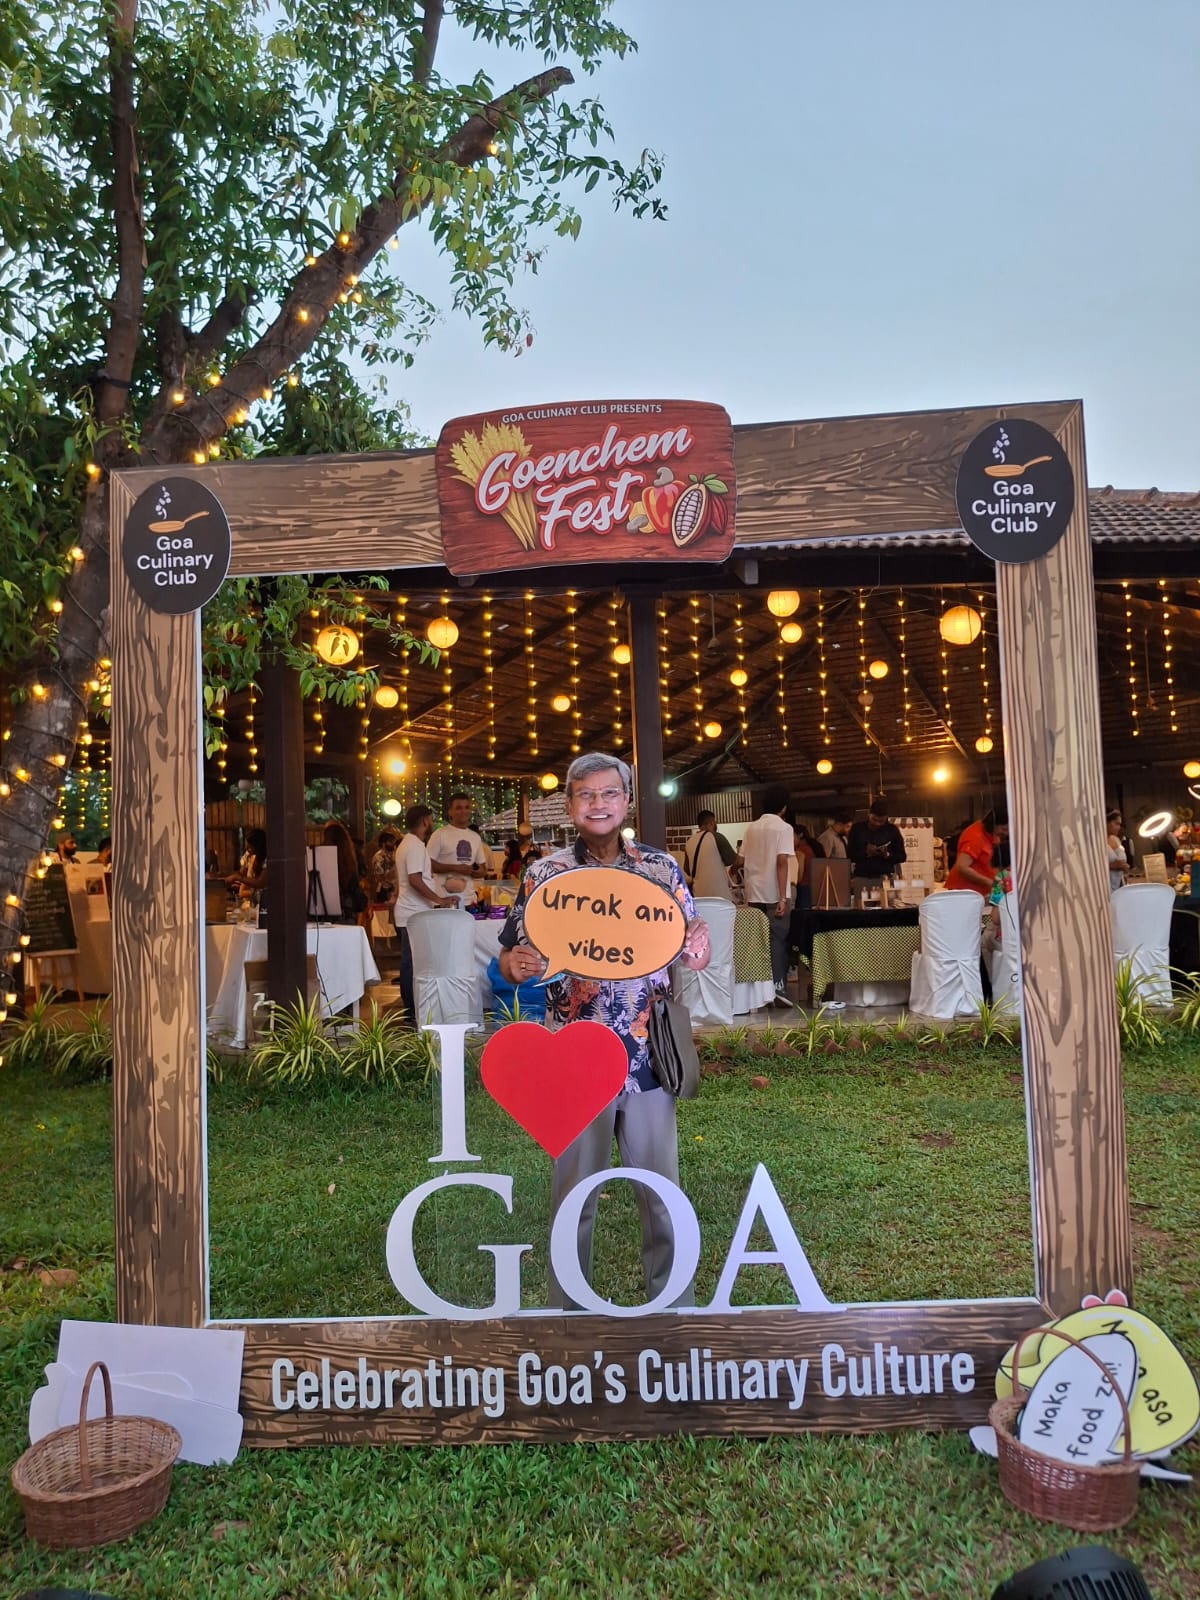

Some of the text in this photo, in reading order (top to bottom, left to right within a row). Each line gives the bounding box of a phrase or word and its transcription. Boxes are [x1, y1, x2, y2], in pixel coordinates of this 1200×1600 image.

[502, 404, 662, 424] GOA CULINARY CLUB PRESENTS
[478, 425, 690, 511] Goenchem
[993, 480, 1034, 496] Goa
[536, 472, 643, 547] Fest
[971, 498, 1057, 518] Culinary
[991, 516, 1038, 533] Club
[156, 536, 193, 550] Goa
[136, 553, 214, 570] Culinary
[154, 569, 197, 586] Club
[542, 887, 674, 922] Urrak ani
[568, 938, 634, 966] vibes
[422, 1022, 482, 1163] I
[385, 1162, 848, 1320] GOA
[271, 1355, 505, 1418] Celebrating
[638, 1348, 809, 1411] Culinary
[822, 1342, 976, 1398] Culture
[1034, 1381, 1072, 1437] Maka
